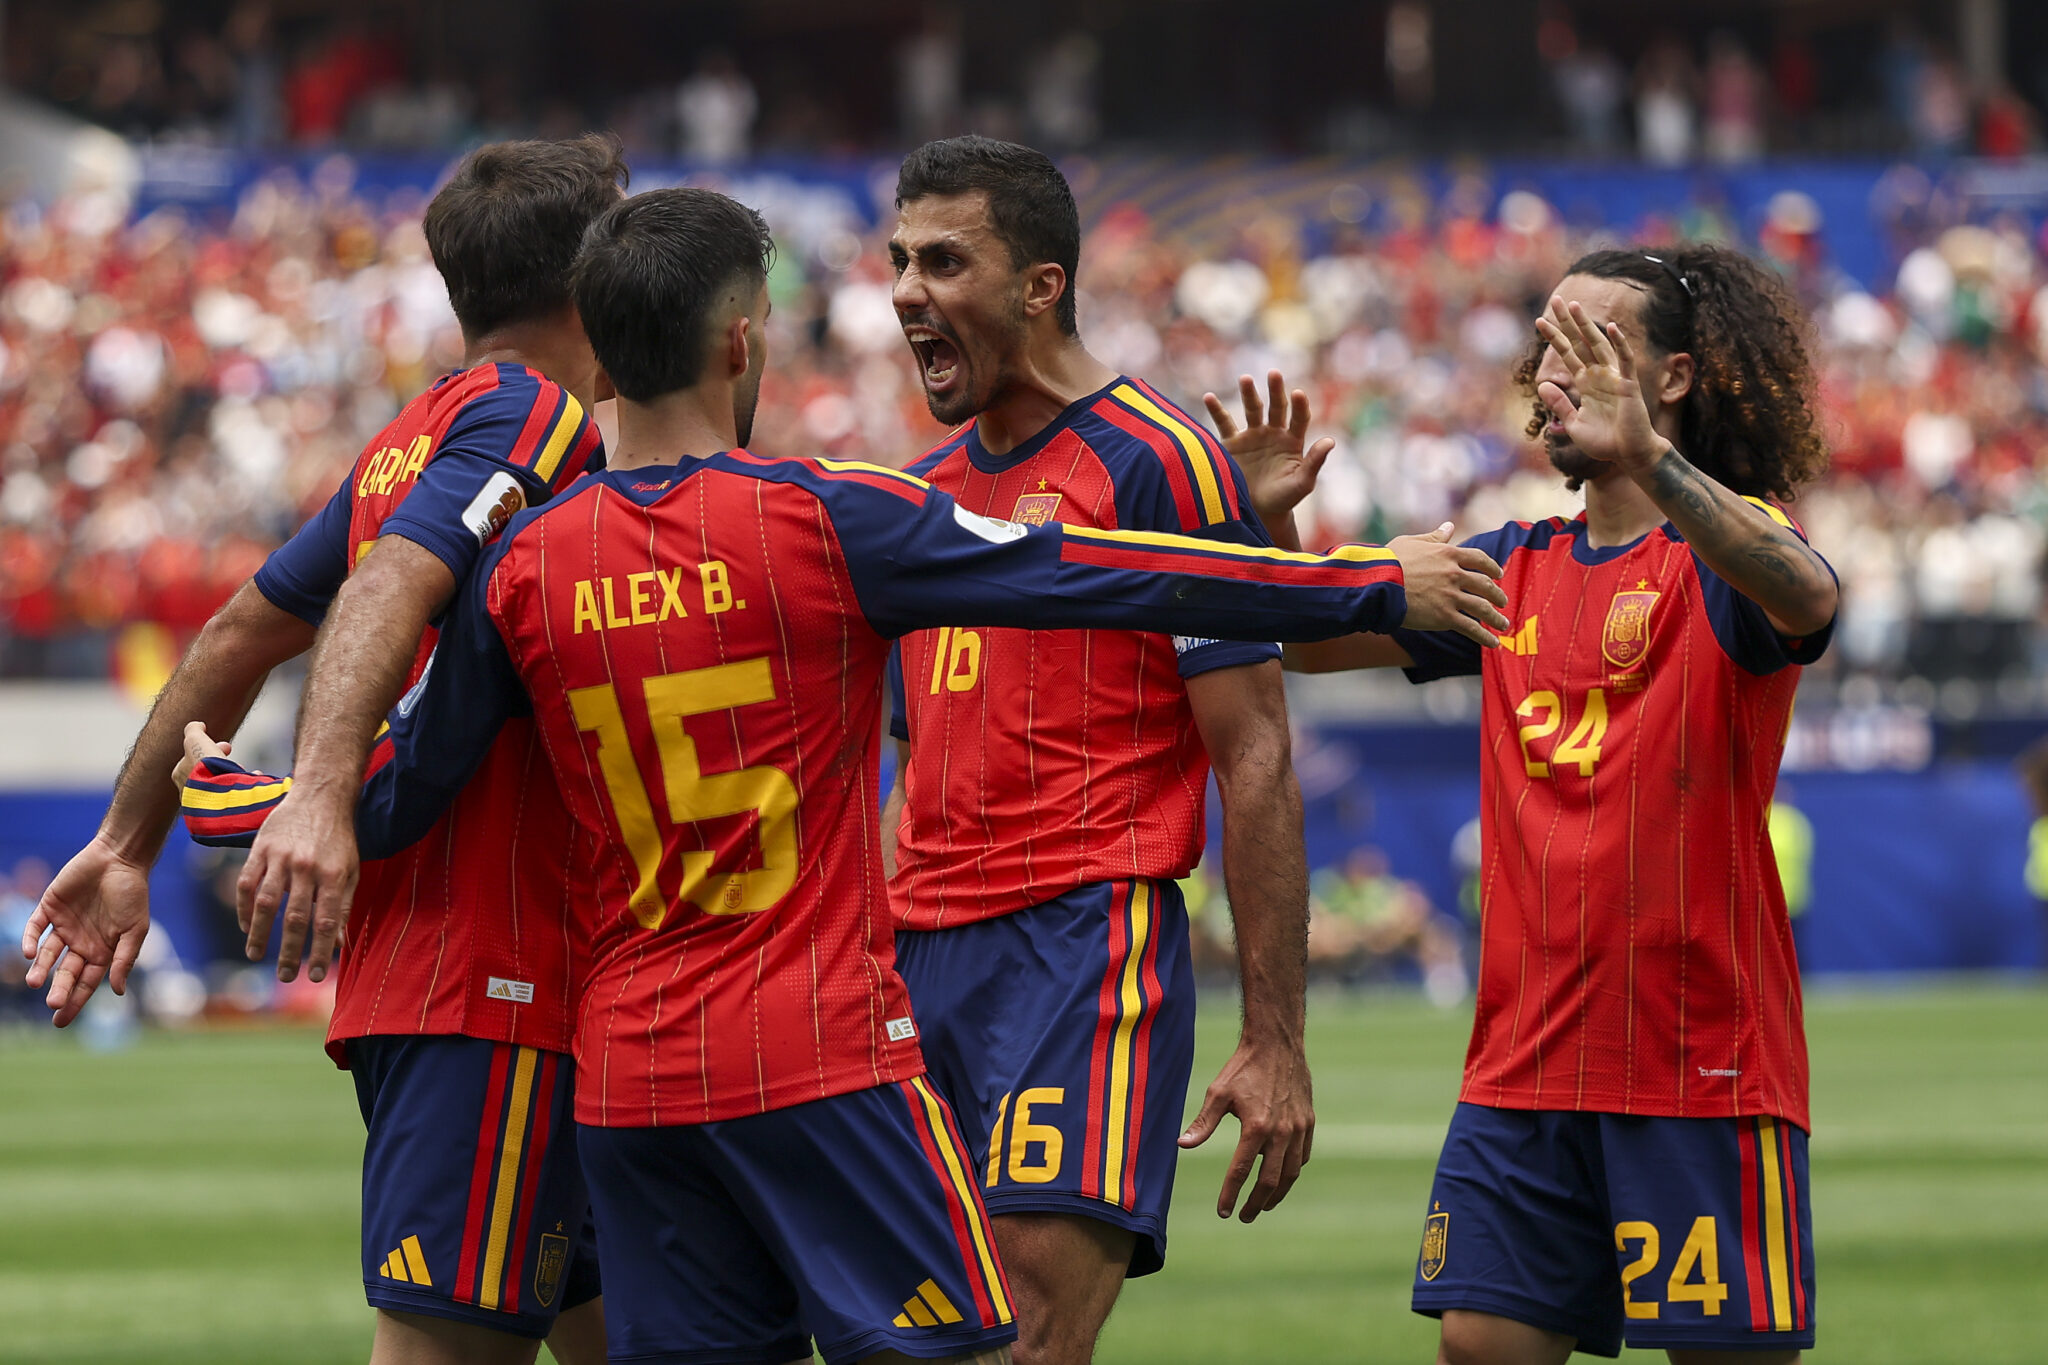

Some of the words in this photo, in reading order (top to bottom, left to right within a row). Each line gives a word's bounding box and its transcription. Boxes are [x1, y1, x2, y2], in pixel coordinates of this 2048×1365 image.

[574, 566, 688, 635] ALEX
[698, 560, 747, 615] B.
[930, 626, 982, 695] 16
[1515, 688, 1608, 778] 24
[567, 656, 799, 930] 15
[986, 1087, 1065, 1188] 16
[1614, 1216, 1728, 1319] 24
